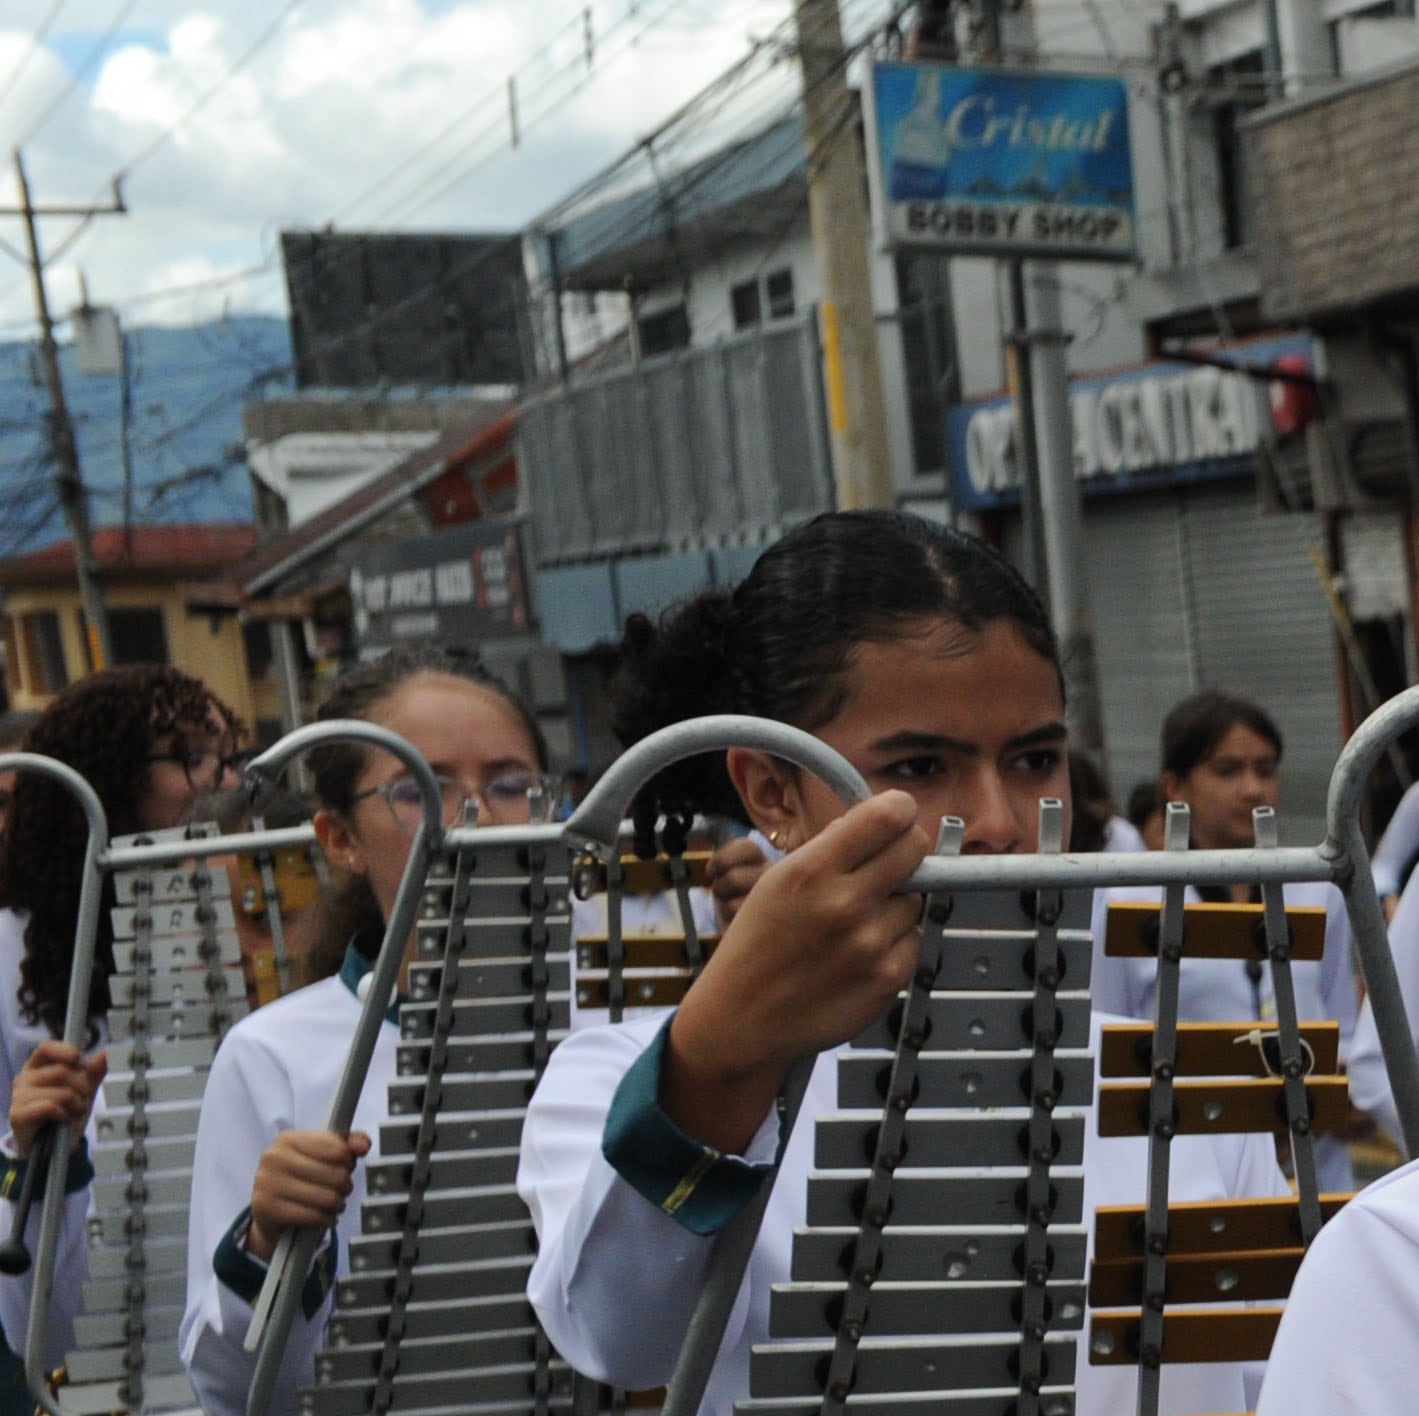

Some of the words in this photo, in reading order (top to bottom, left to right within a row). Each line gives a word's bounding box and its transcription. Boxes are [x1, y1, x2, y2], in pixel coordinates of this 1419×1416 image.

[946, 94, 1115, 153] Cristal
[908, 204, 1019, 239] BOBBY
[1034, 207, 1121, 241] SHOP
